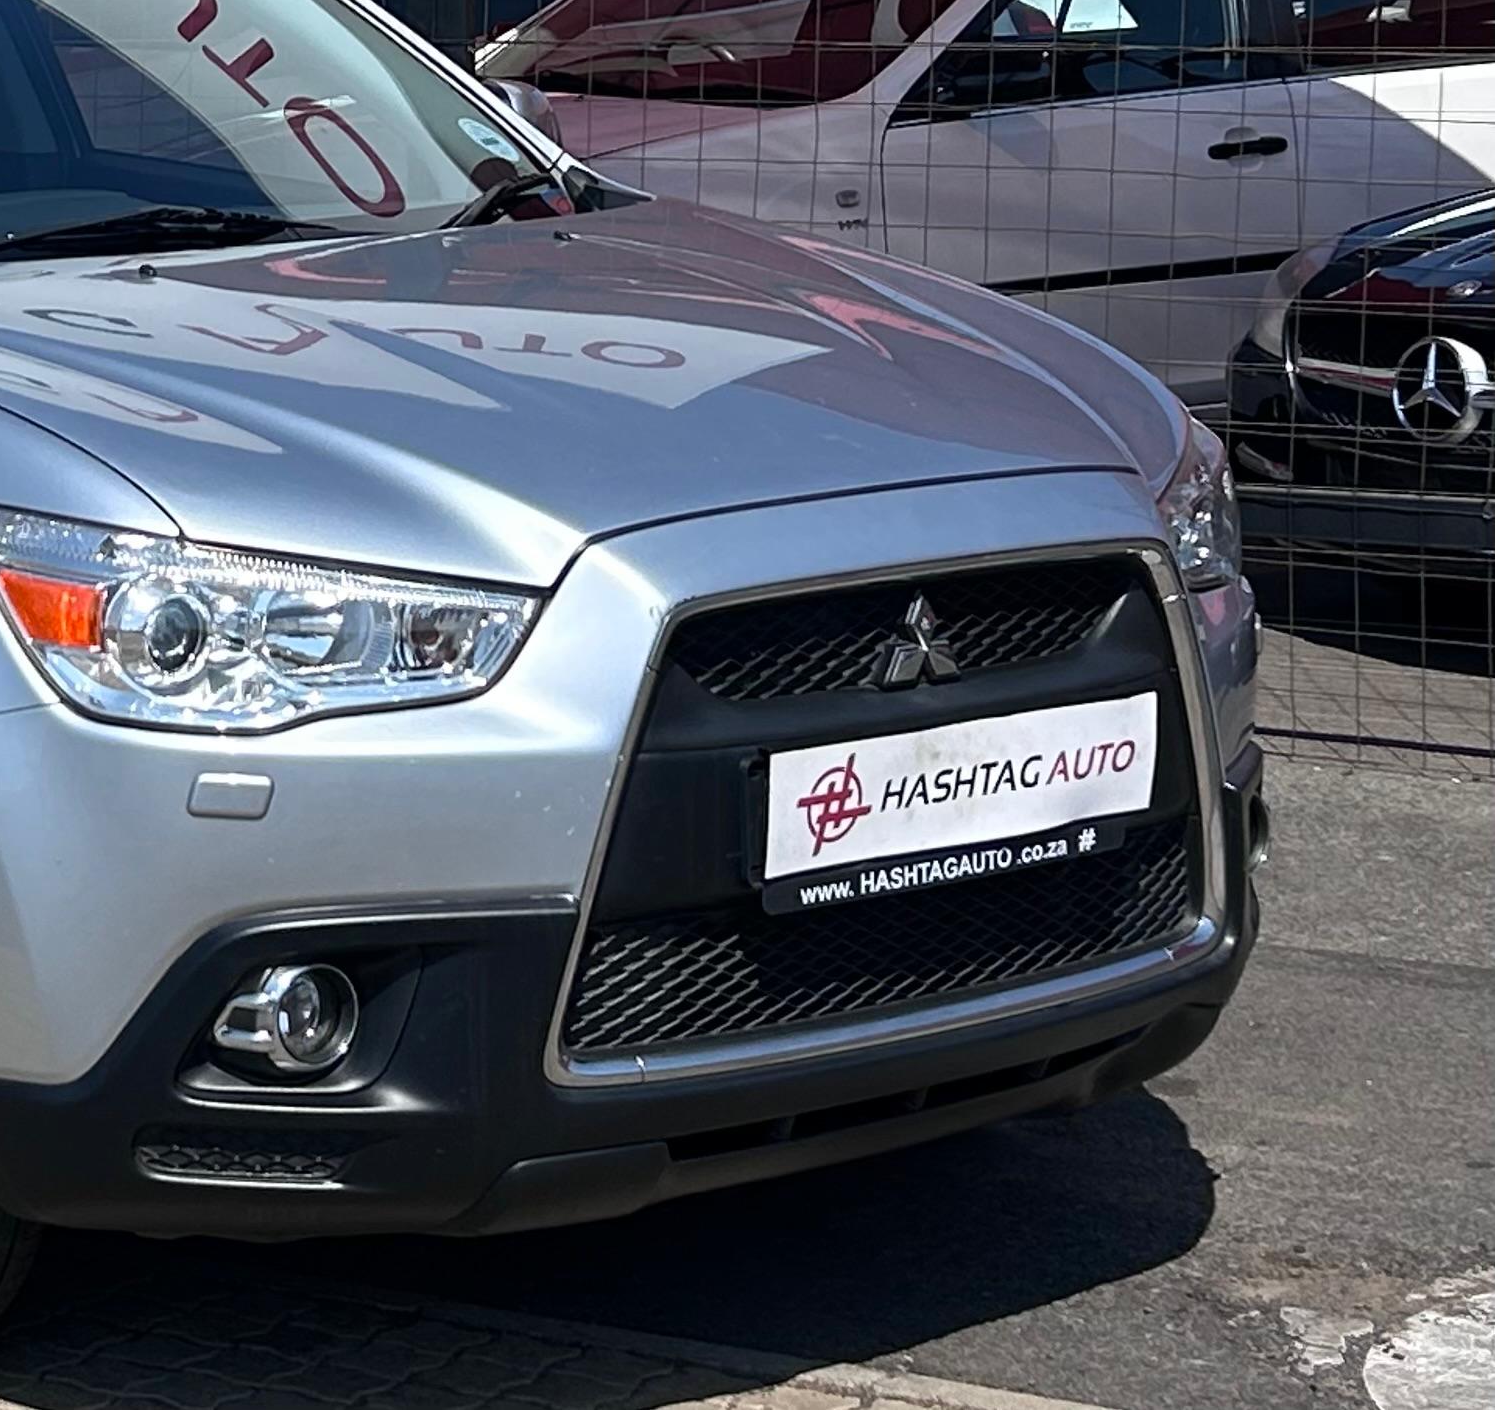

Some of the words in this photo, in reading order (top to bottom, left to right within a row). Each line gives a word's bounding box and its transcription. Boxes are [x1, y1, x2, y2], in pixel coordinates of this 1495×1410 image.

[881, 755, 1043, 812] HASHTAG
[1046, 740, 1136, 784] AUTO
[800, 880, 855, 905] www.
[860, 847, 1013, 894] HASHTAGAUTO
[1016, 839, 1068, 865] .co.za
